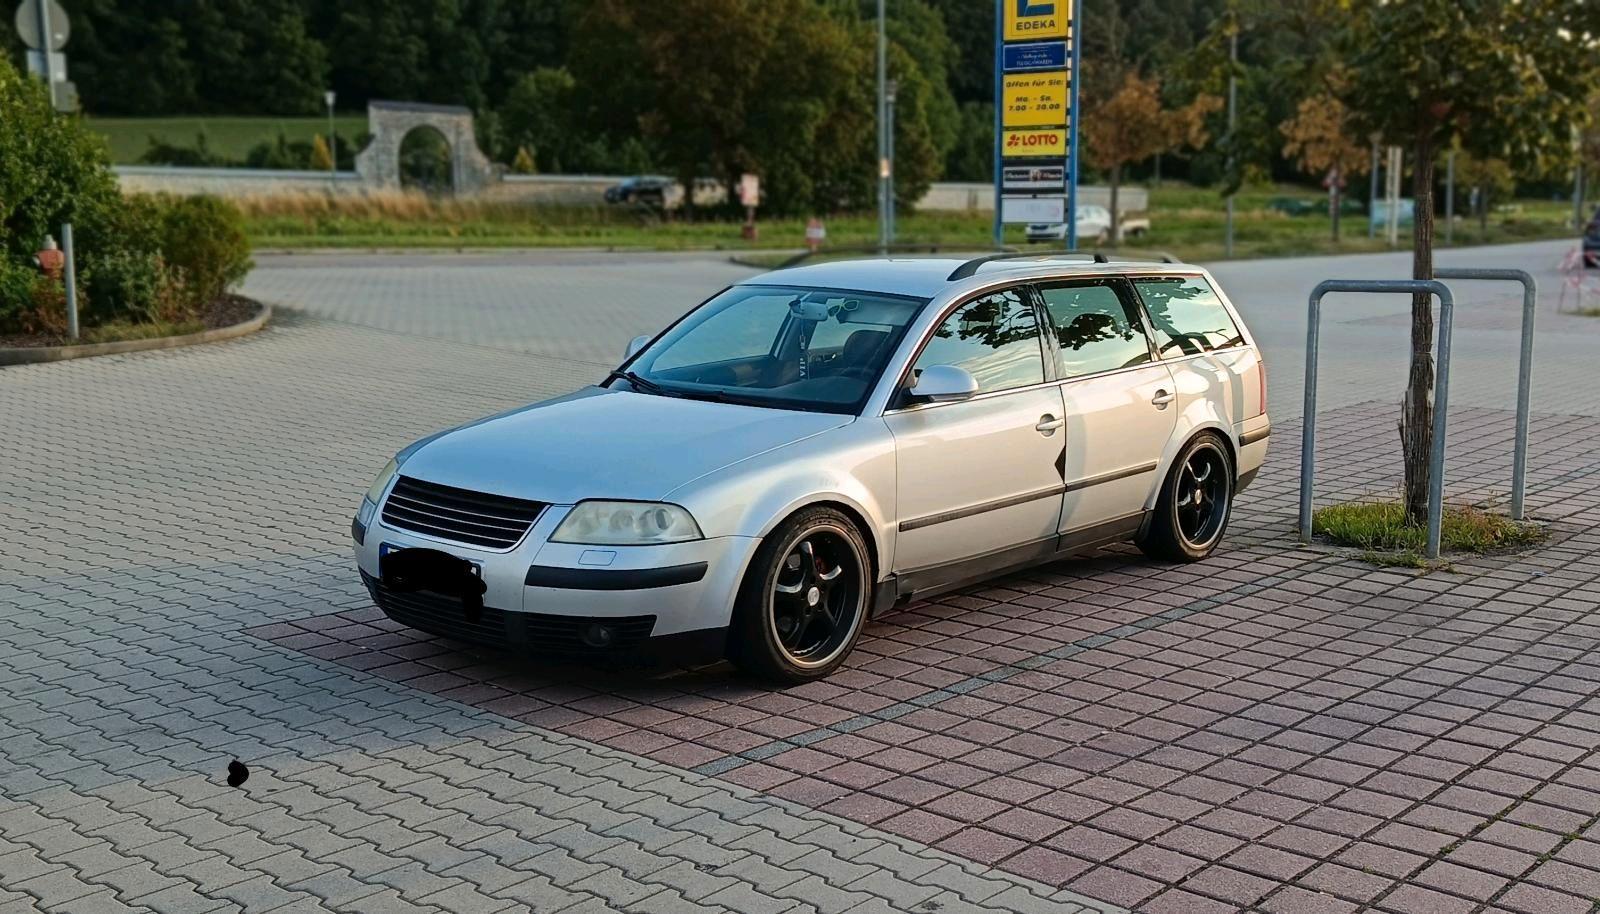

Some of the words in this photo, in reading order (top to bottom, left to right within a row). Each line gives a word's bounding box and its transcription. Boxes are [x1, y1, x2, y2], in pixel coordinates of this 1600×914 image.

[1016, 20, 1055, 31] EDEKA
[1032, 79, 1046, 87] für
[1036, 103, 1060, 111] 20.00
[1023, 134, 1058, 145] LOTTO
